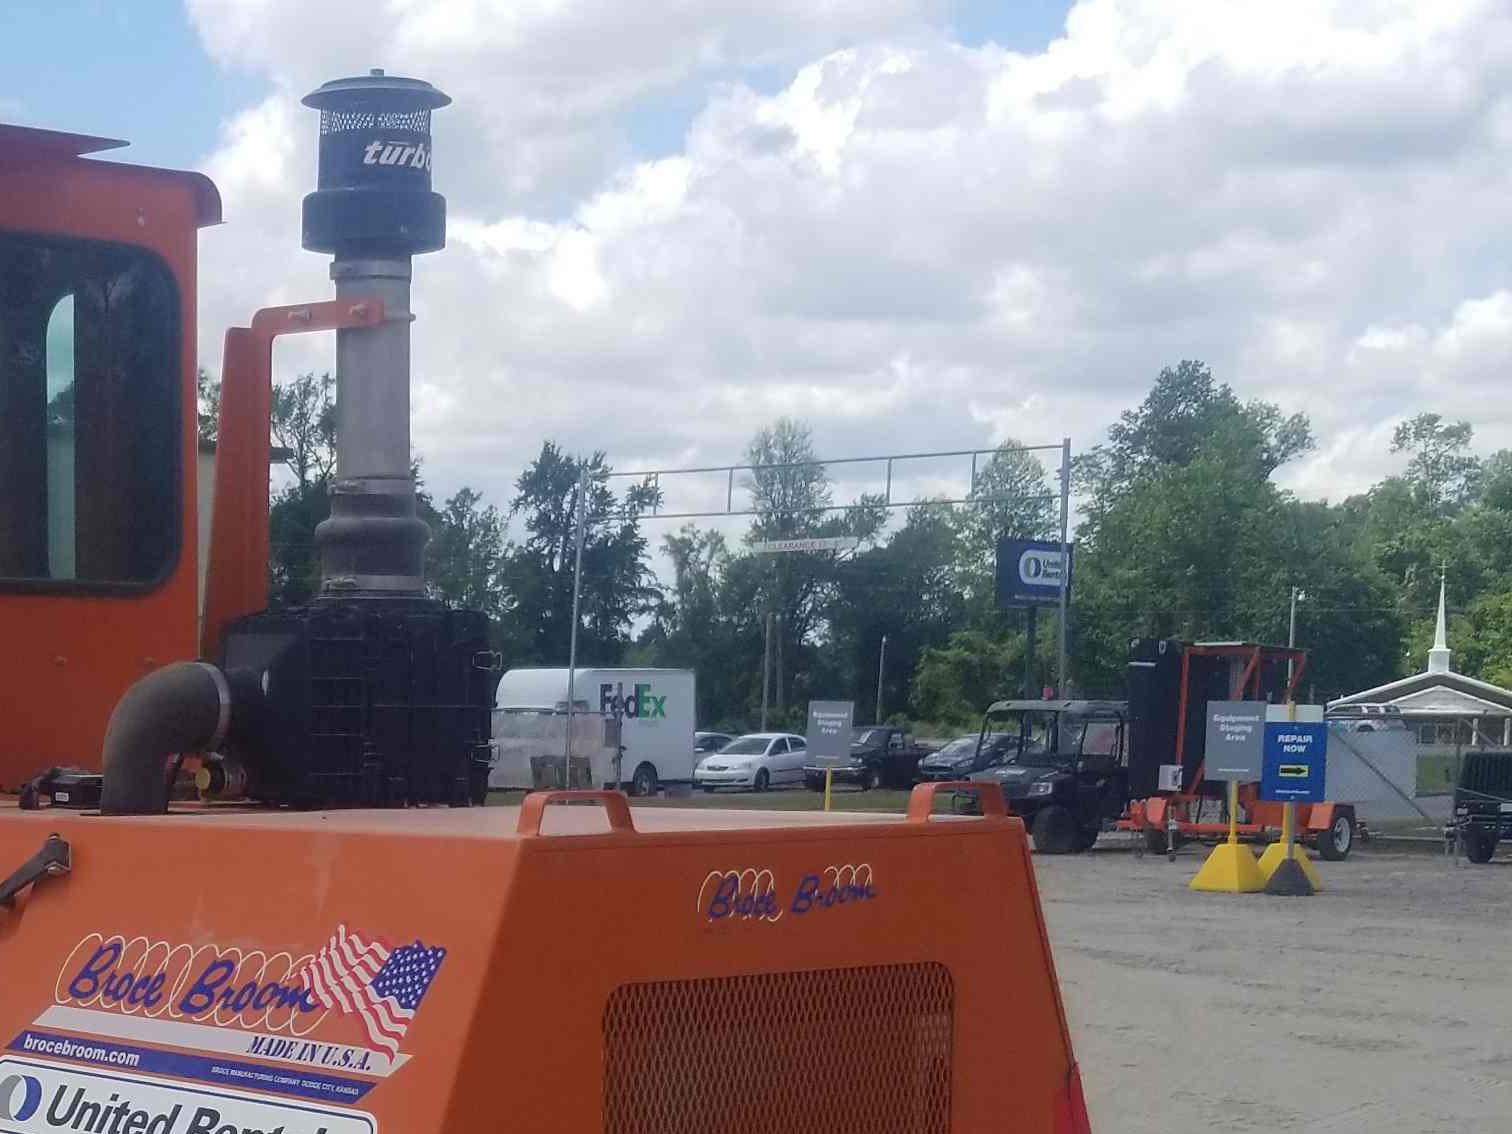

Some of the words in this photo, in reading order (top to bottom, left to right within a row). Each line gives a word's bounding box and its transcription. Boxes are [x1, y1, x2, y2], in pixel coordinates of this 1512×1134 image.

[1225, 733, 1247, 741] Area
[1277, 734, 1313, 744] REPAIR
[1283, 744, 1307, 753] NOW
[66, 940, 166, 1011] Broce
[178, 958, 322, 1016] Broom
[23, 1034, 140, 1067] brocebroom.com
[246, 1035, 297, 1058] MADE
[296, 1042, 322, 1062] IN
[321, 1046, 372, 1071] U.S.A.
